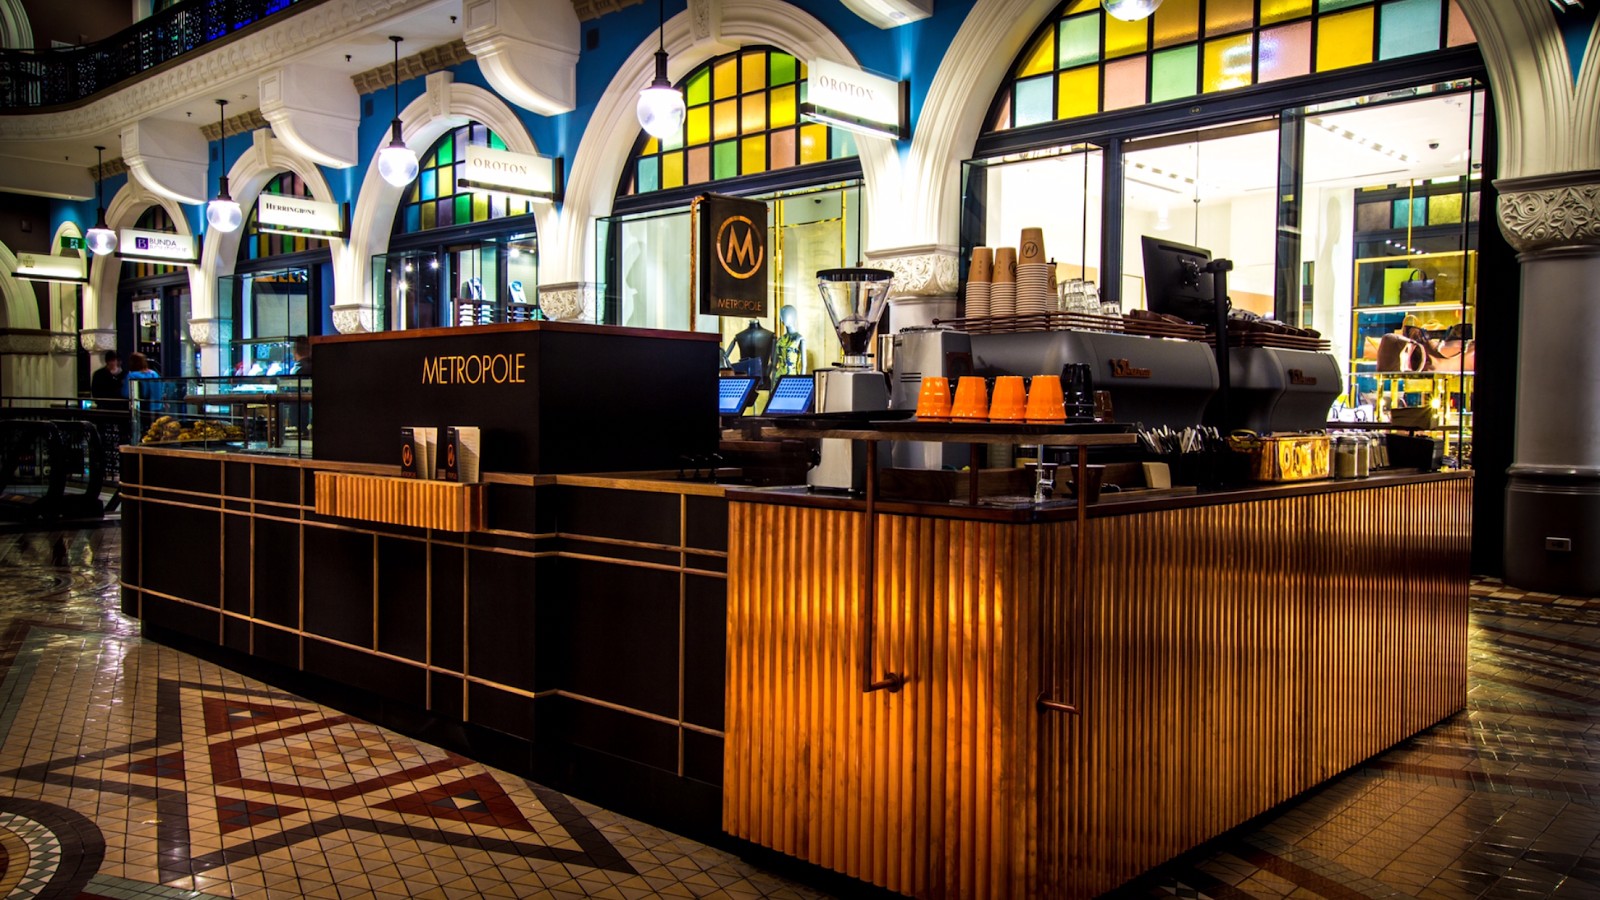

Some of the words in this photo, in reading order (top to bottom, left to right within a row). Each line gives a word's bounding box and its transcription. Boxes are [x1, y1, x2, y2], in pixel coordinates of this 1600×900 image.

[820, 75, 874, 100] OROTON
[473, 158, 527, 174] OROTON
[149, 237, 177, 247] BUNDA
[726, 225, 755, 266] M
[718, 298, 762, 312] METROPOLE
[422, 353, 526, 384] METROPOLE
